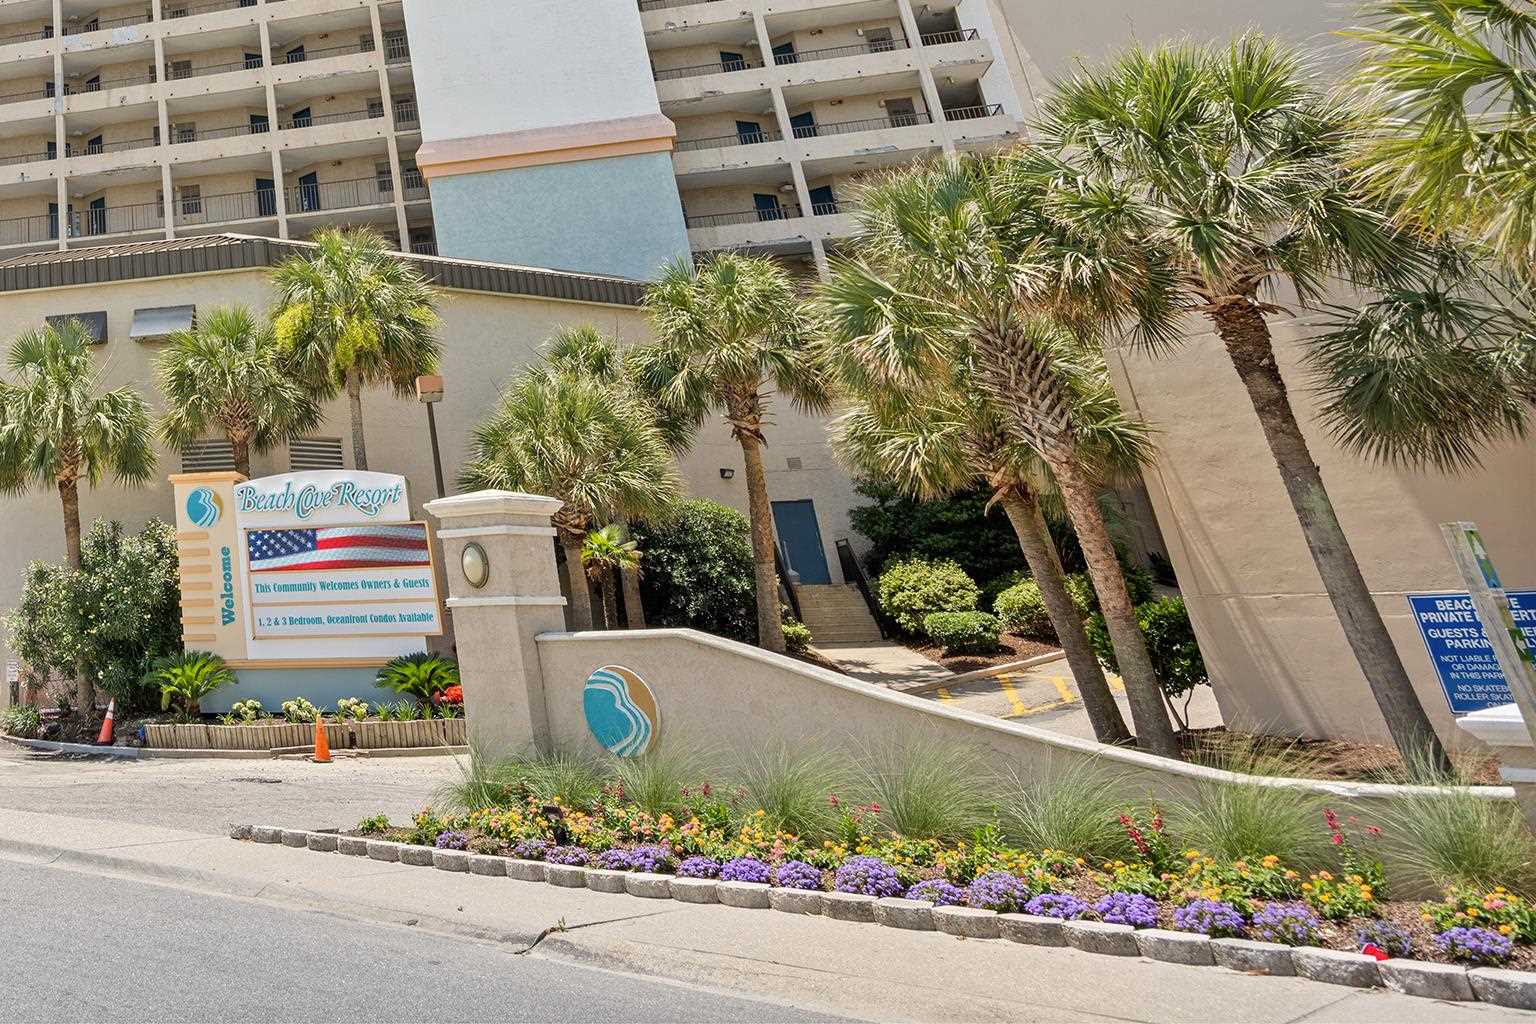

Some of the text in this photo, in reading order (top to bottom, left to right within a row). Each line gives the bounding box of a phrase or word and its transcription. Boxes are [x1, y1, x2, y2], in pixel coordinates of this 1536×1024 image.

[238, 481, 403, 519] Beach Cove Resort
[220, 546, 235, 626] Welcome
[255, 578, 430, 593] This Community Welcomes Owners & Guests
[1435, 599, 1472, 611] BEAC
[274, 617, 280, 626] &
[282, 617, 287, 626] 3
[327, 615, 368, 625] Oceanfront
[370, 614, 396, 623] Condos
[399, 613, 433, 623] Available
[1421, 611, 1474, 623] PRIVATE
[1428, 628, 1479, 638] GUESTS
[1445, 639, 1492, 649] PARKIN
[1440, 655, 1459, 663] NOT
[1460, 655, 1491, 663] LIABLE
[1450, 671, 1504, 680] IN THIS PARK
